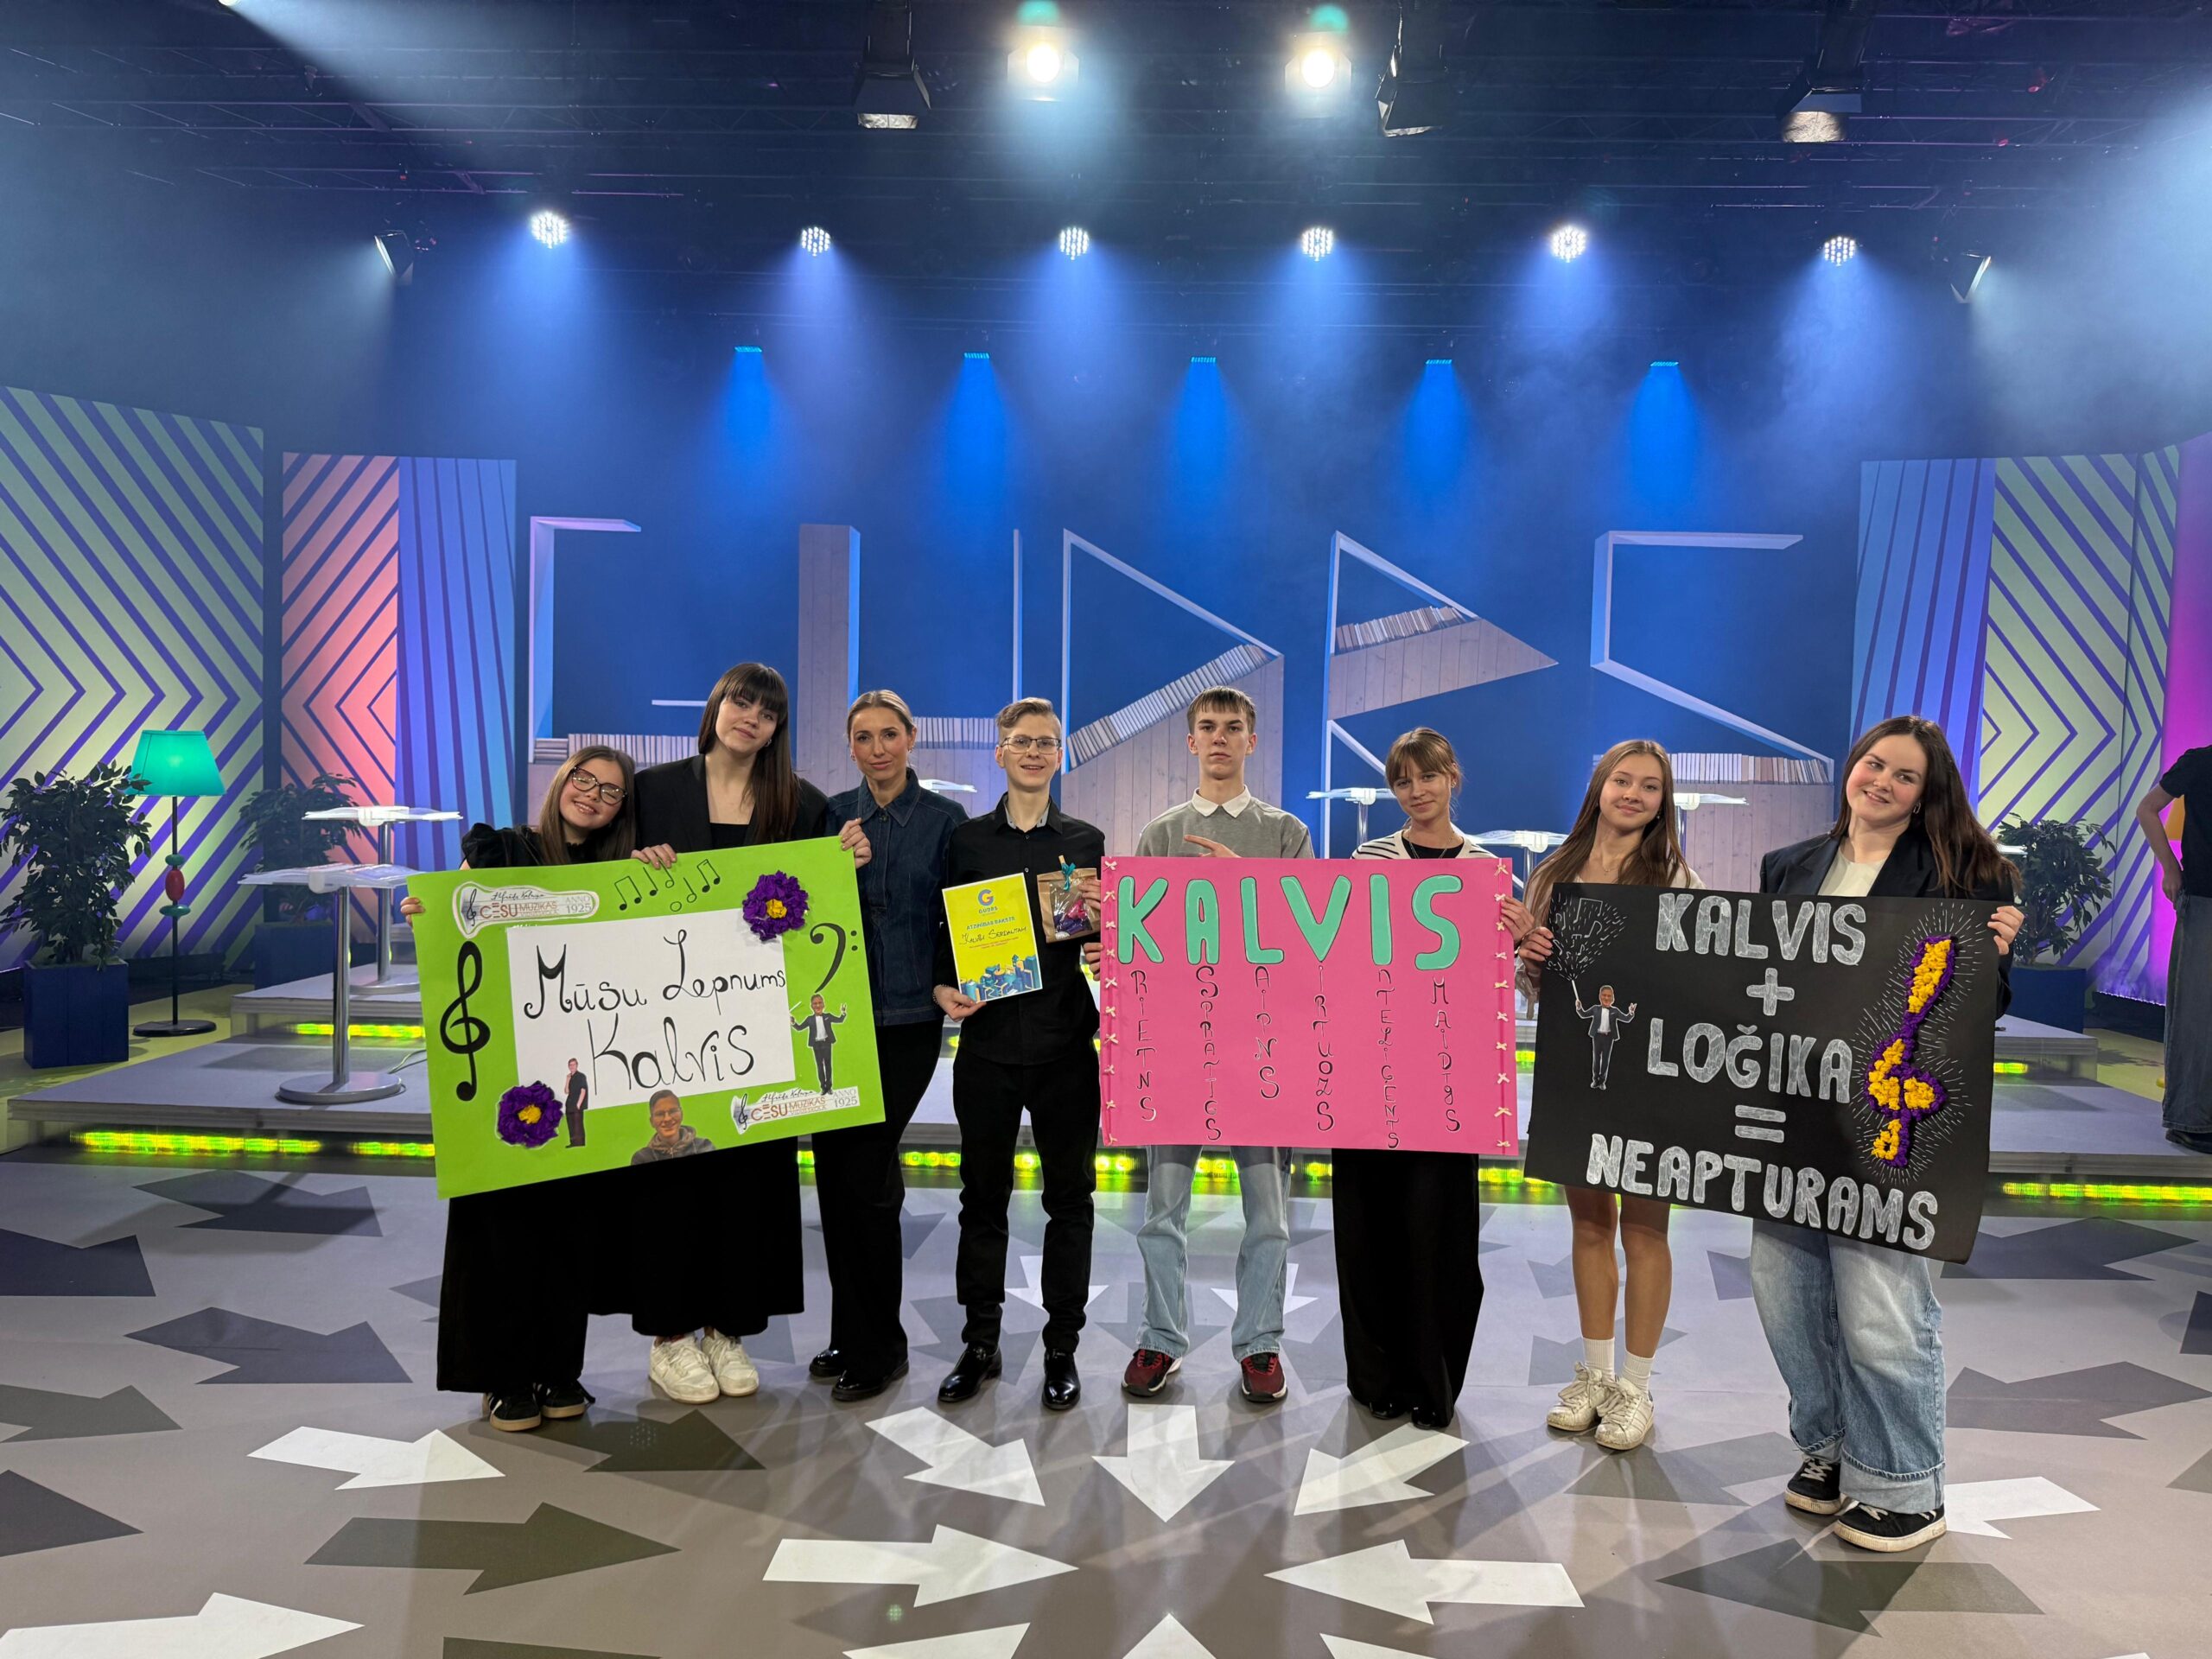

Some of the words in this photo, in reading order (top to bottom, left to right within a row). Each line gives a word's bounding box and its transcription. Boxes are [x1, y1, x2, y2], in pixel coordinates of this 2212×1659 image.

[566, 905, 592, 914] 1925
[1117, 874, 1463, 970] KALVIS
[1656, 893, 1866, 966] KALVIS
[524, 944, 647, 1019] Mūsu
[663, 929, 786, 1014] Lepnums
[588, 1013, 754, 1096] Kalvis
[832, 1089, 856, 1097] ANNO
[834, 1097, 858, 1108] 1925
[1586, 1133, 1937, 1250] NEAPTURAMS
